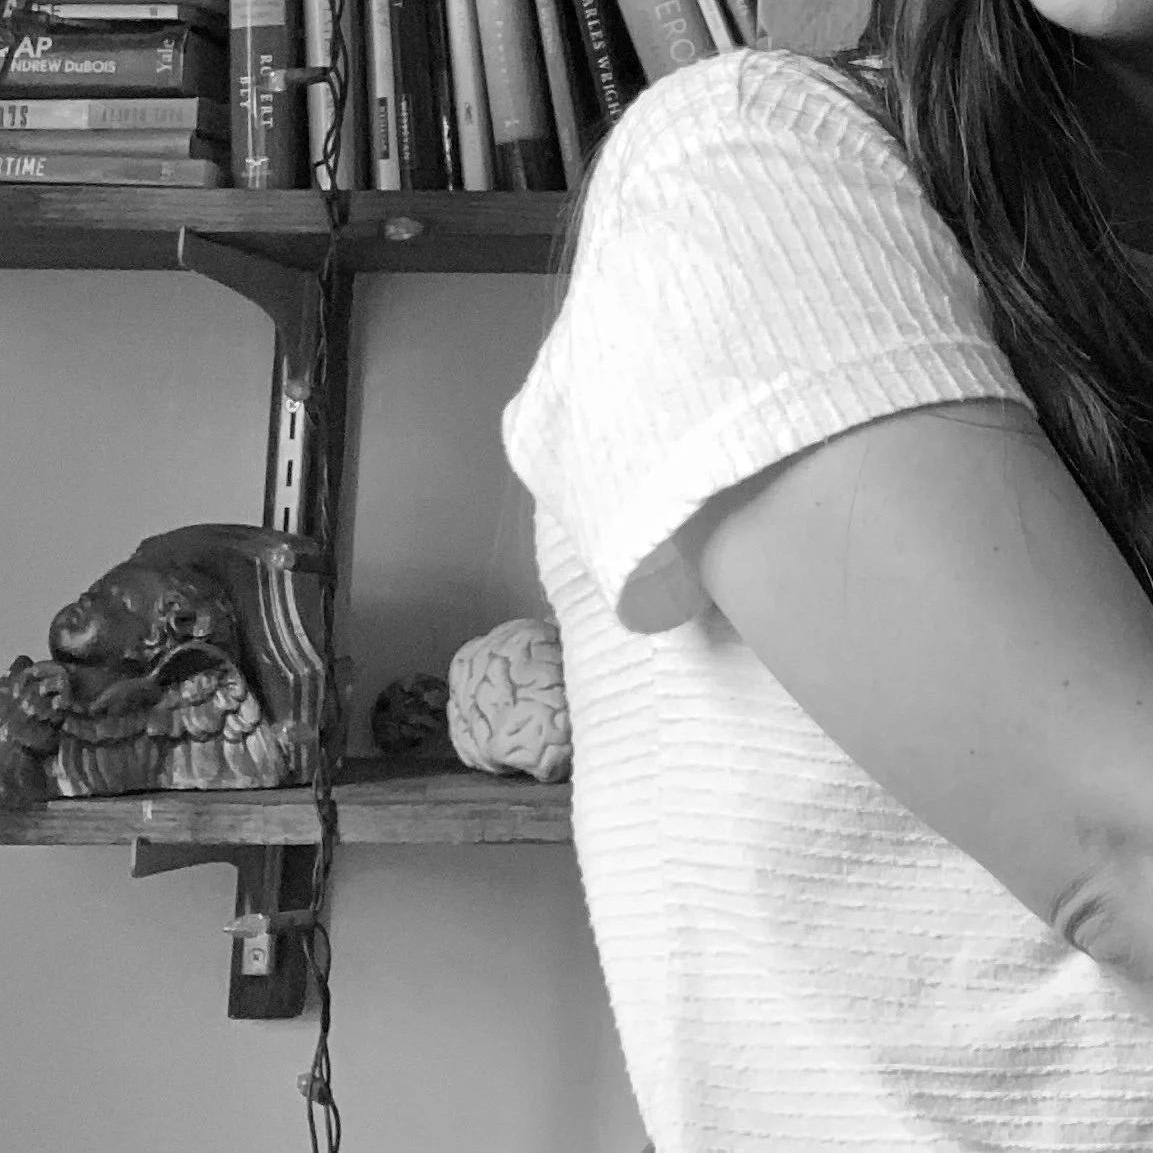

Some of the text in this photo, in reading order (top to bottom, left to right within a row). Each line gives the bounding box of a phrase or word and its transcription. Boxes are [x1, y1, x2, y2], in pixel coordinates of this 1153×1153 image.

[8, 59, 116, 74] NDREW DuBOIS
[156, 38, 175, 74] Yale
[239, 76, 252, 108] BLY
[260, 53, 274, 129] ROERT
[595, 54, 622, 121] WRIGH
[0, 105, 29, 128] SL
[0, 156, 48, 177] TIME
